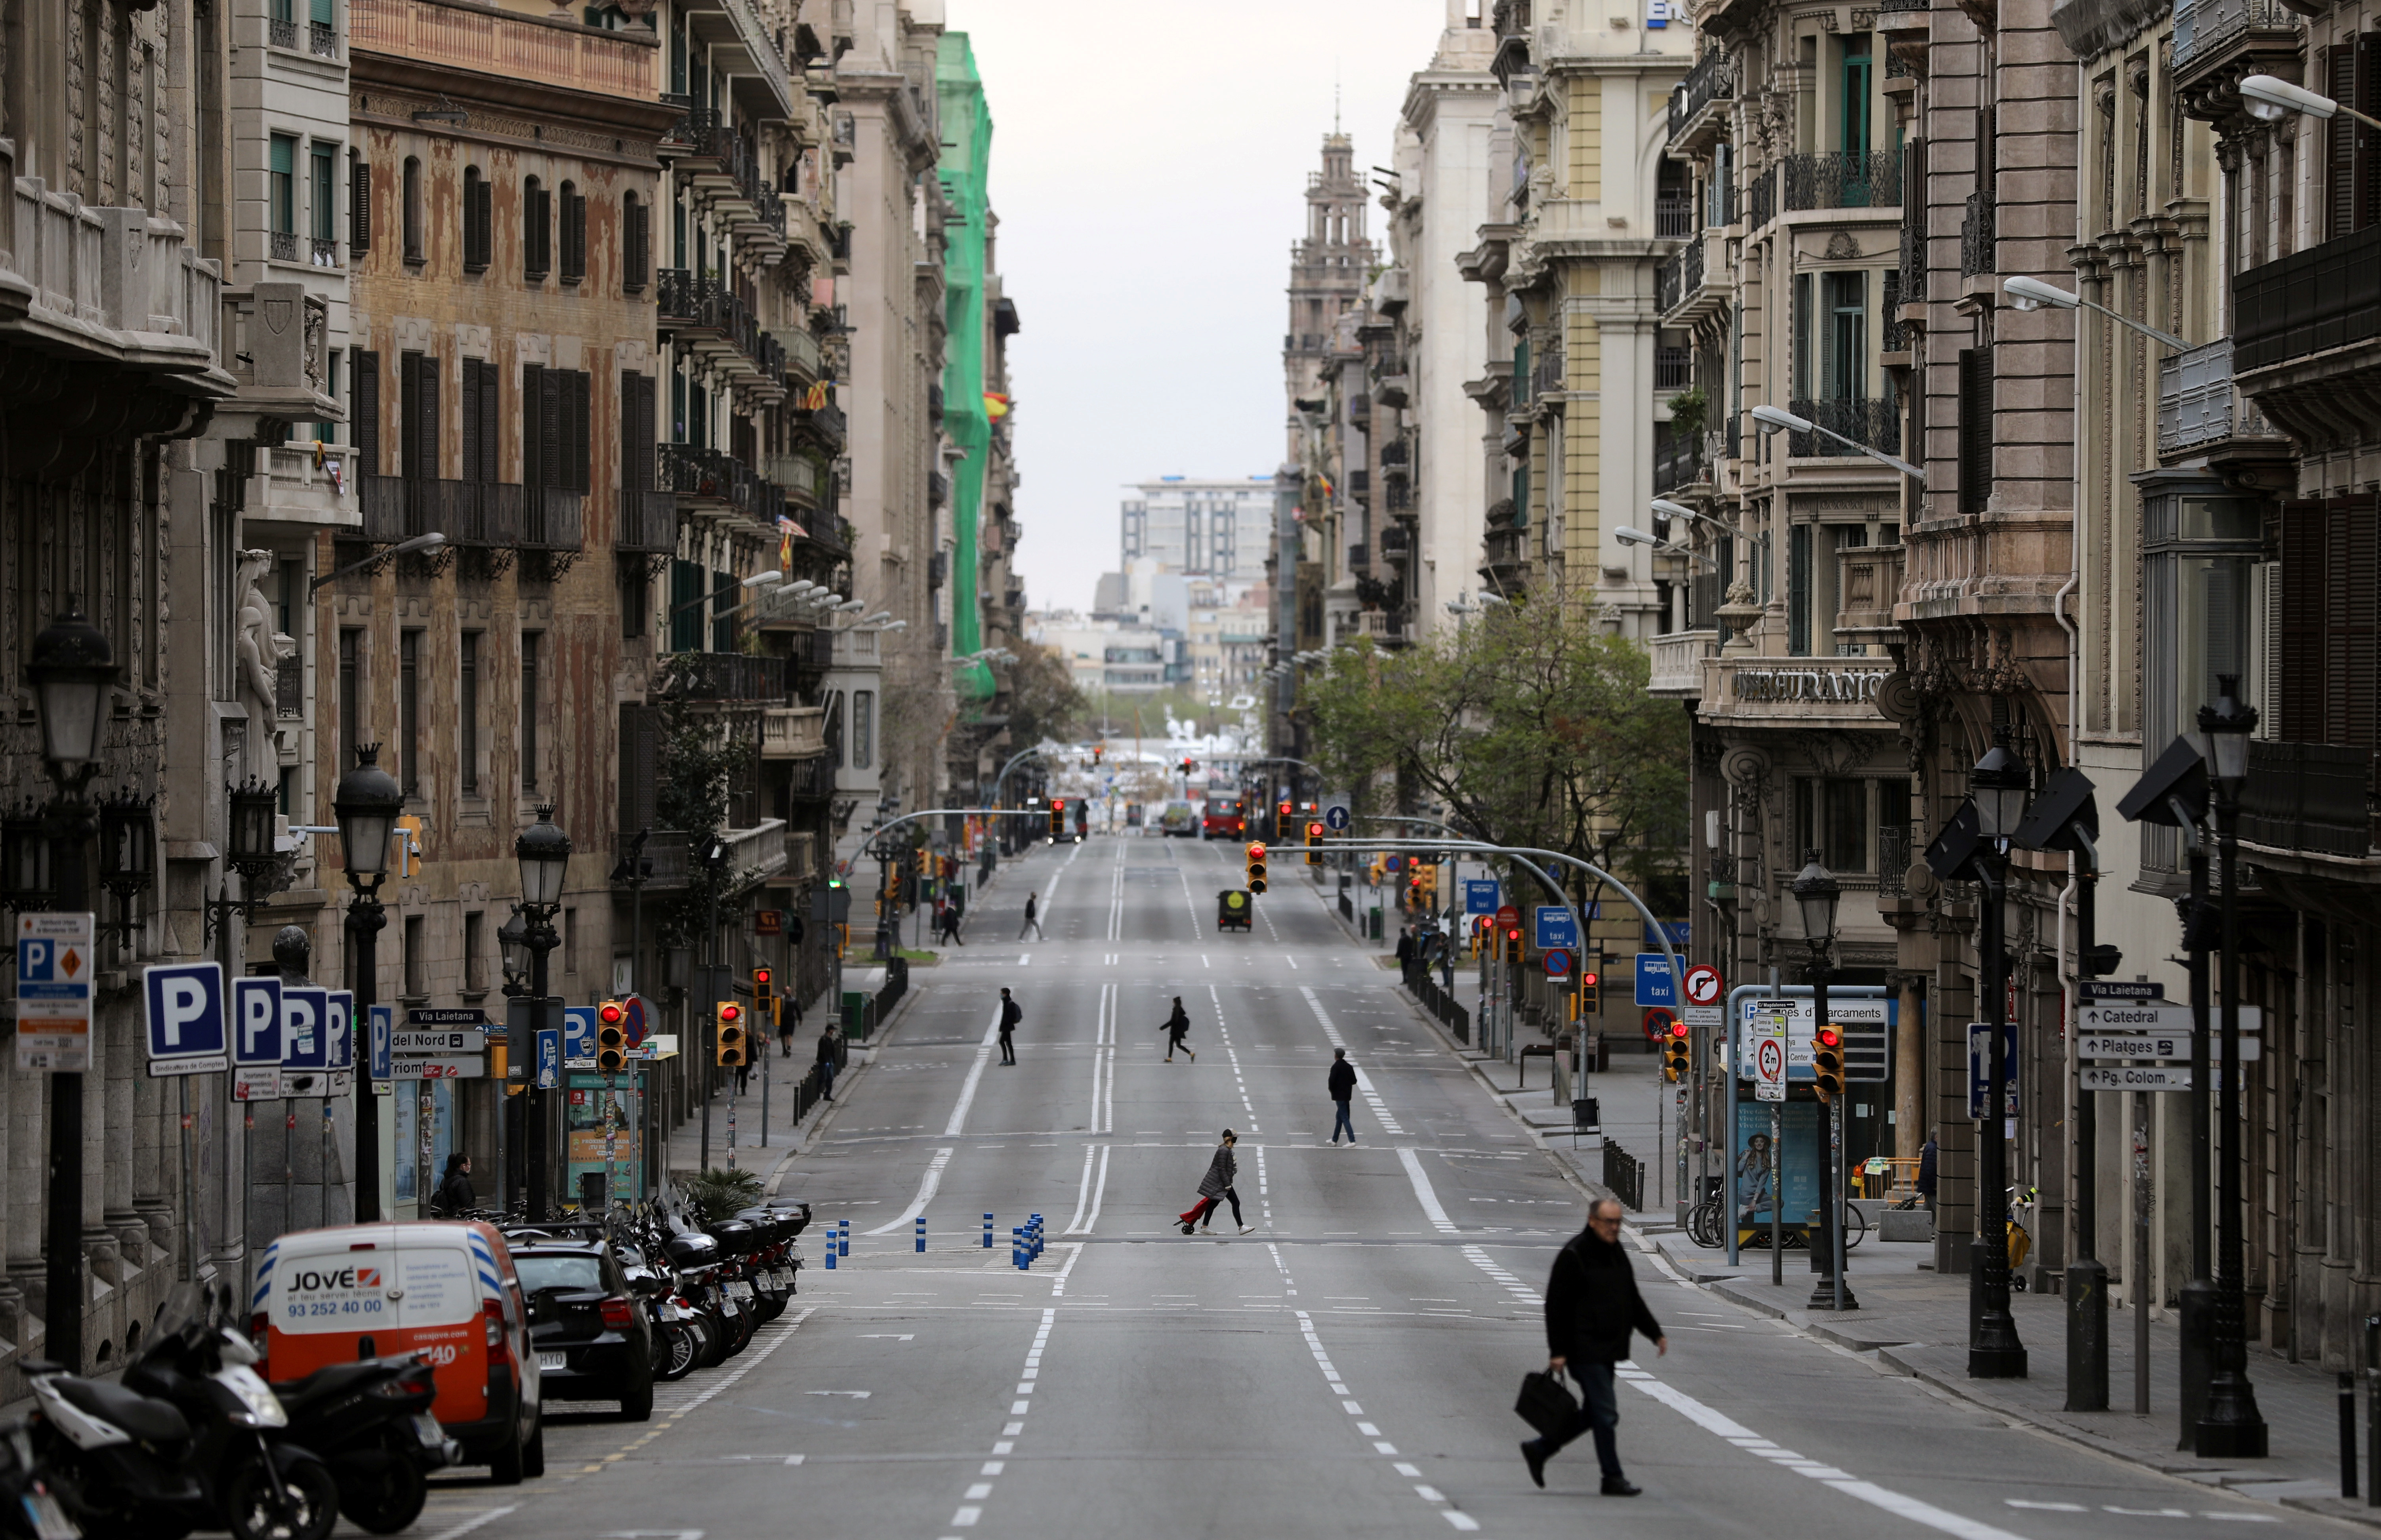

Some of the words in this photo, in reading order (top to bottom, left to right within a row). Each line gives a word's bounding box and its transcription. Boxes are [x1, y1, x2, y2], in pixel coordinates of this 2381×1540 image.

[27, 942, 46, 978] P
[1651, 986, 1669, 996] taxi
[2091, 985, 2107, 995] Via
[2110, 985, 2152, 995] Laietana
[162, 976, 207, 1046] P
[419, 1012, 433, 1021] Via
[436, 1012, 474, 1021] Laietana
[2103, 1010, 2158, 1023] Catedral
[244, 989, 272, 1053] P
[282, 999, 315, 1060] P
[328, 1002, 345, 1061] P
[374, 1015, 386, 1070] P
[392, 1034, 410, 1046] del
[415, 1034, 445, 1046] Nord
[2102, 1039, 2153, 1055] Platges
[1765, 1052, 1770, 1064] 2
[155, 1063, 188, 1073] Sindicatura
[198, 1061, 225, 1070] Comptes
[2102, 1071, 2121, 1086] Pg.
[2126, 1071, 2165, 1084] Colom
[287, 1265, 354, 1292] JOVÉ
[288, 1303, 305, 1317] 93
[311, 1302, 337, 1316] 252
[342, 1301, 359, 1313] 40
[364, 1300, 382, 1313] 00
[727, 1306, 736, 1314] KCL
[414, 1330, 467, 1341] casajove.com
[540, 1353, 563, 1365] HYD
